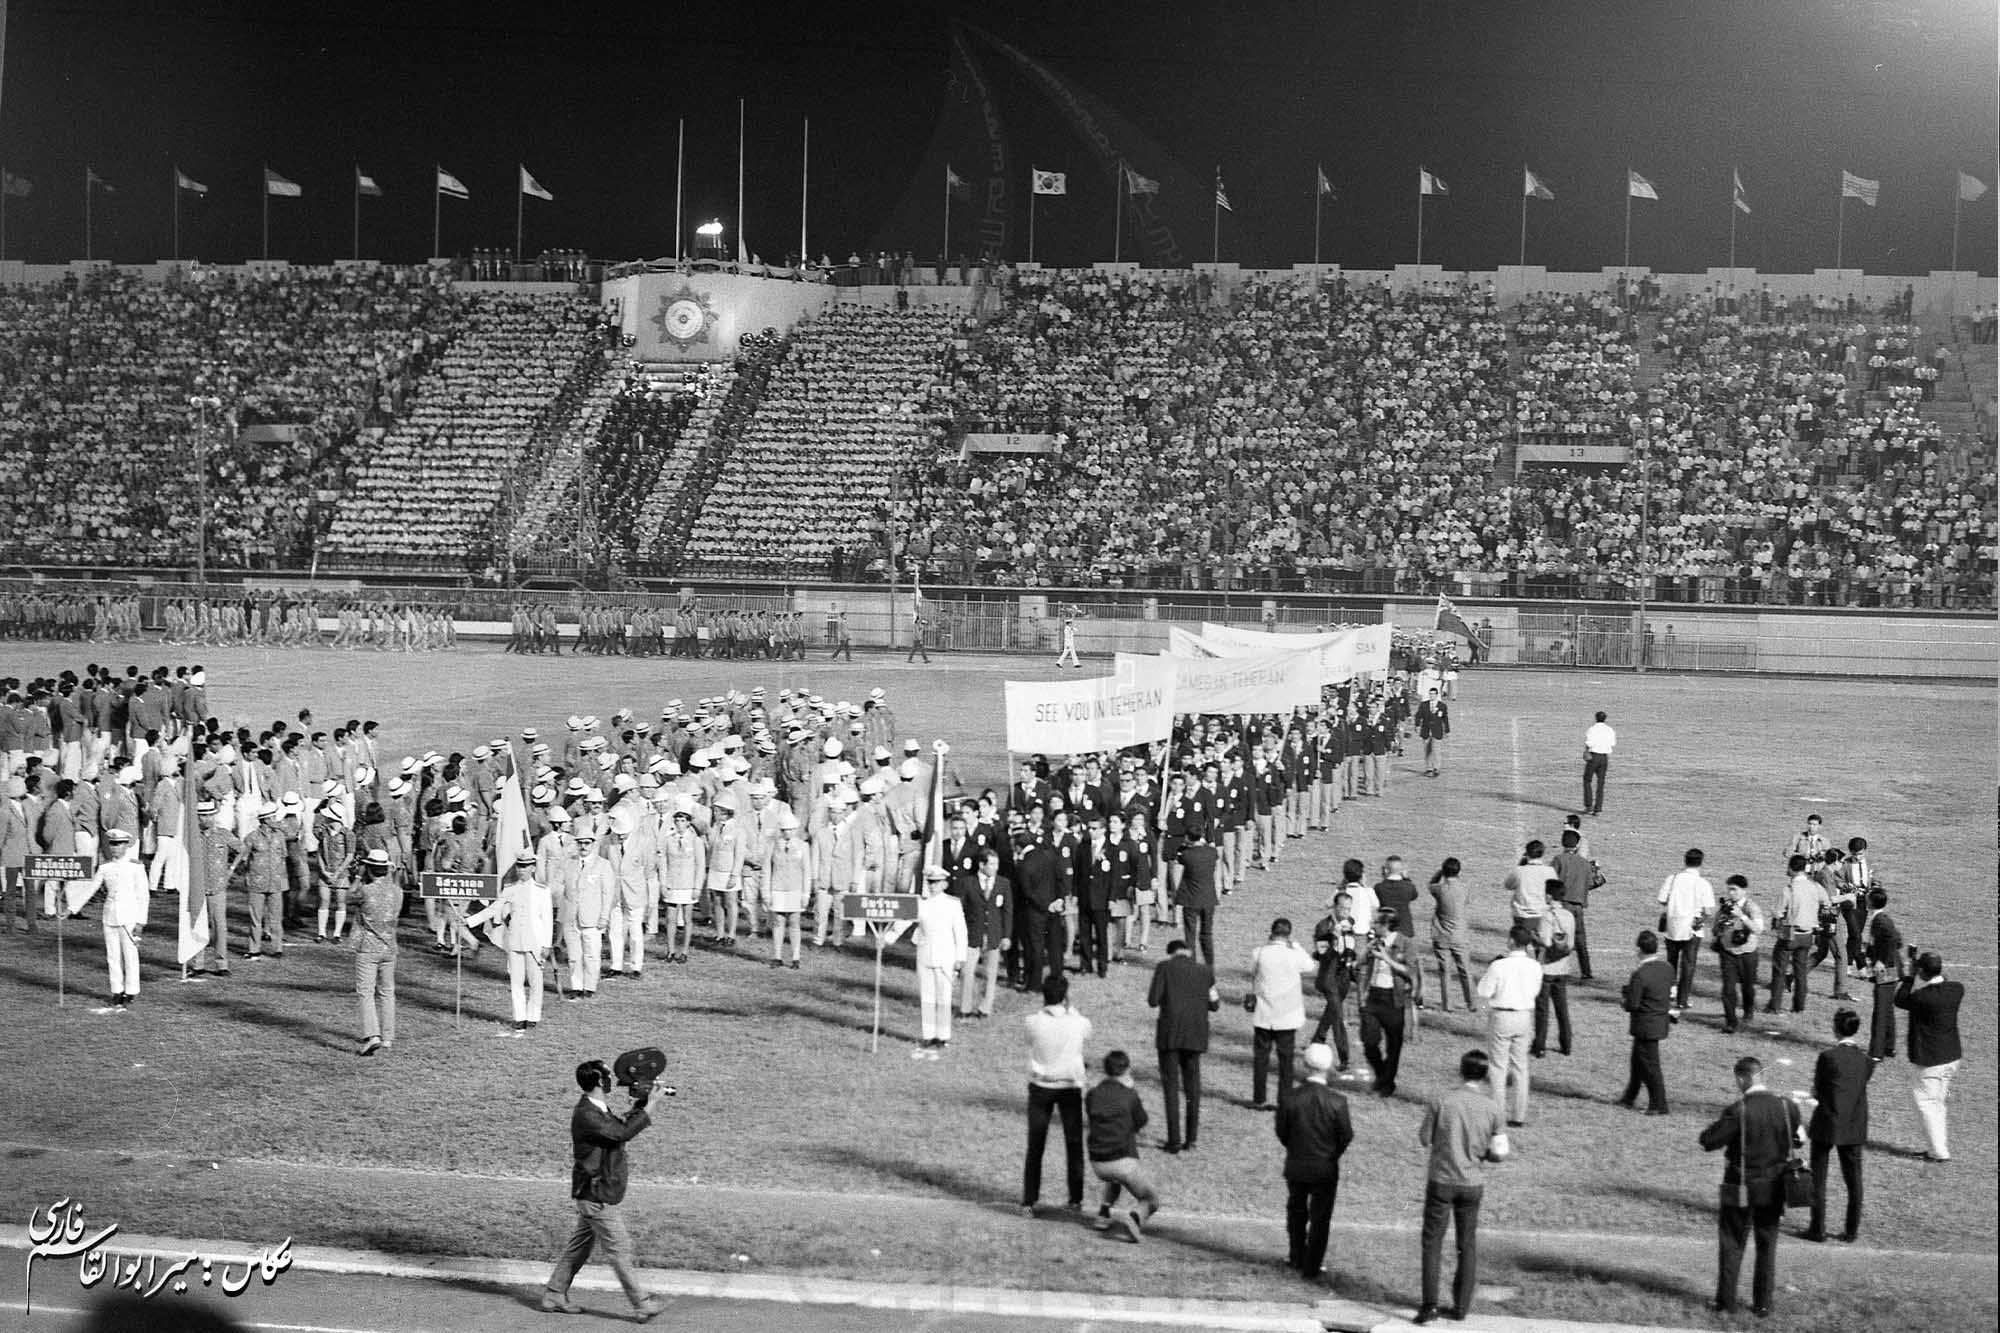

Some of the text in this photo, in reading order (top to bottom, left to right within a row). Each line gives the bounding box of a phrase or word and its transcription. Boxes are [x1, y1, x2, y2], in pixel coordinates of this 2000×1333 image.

[1007, 436, 1020, 445] 12
[1569, 448, 1584, 457] 13
[1035, 703, 1058, 722] SEE
[1094, 699, 1105, 719] IN
[1110, 689, 1162, 716] TEHERAN
[31, 869, 85, 878] INDONESIA
[439, 887, 480, 896] ISRAEL
[866, 909, 895, 918] IRAN
